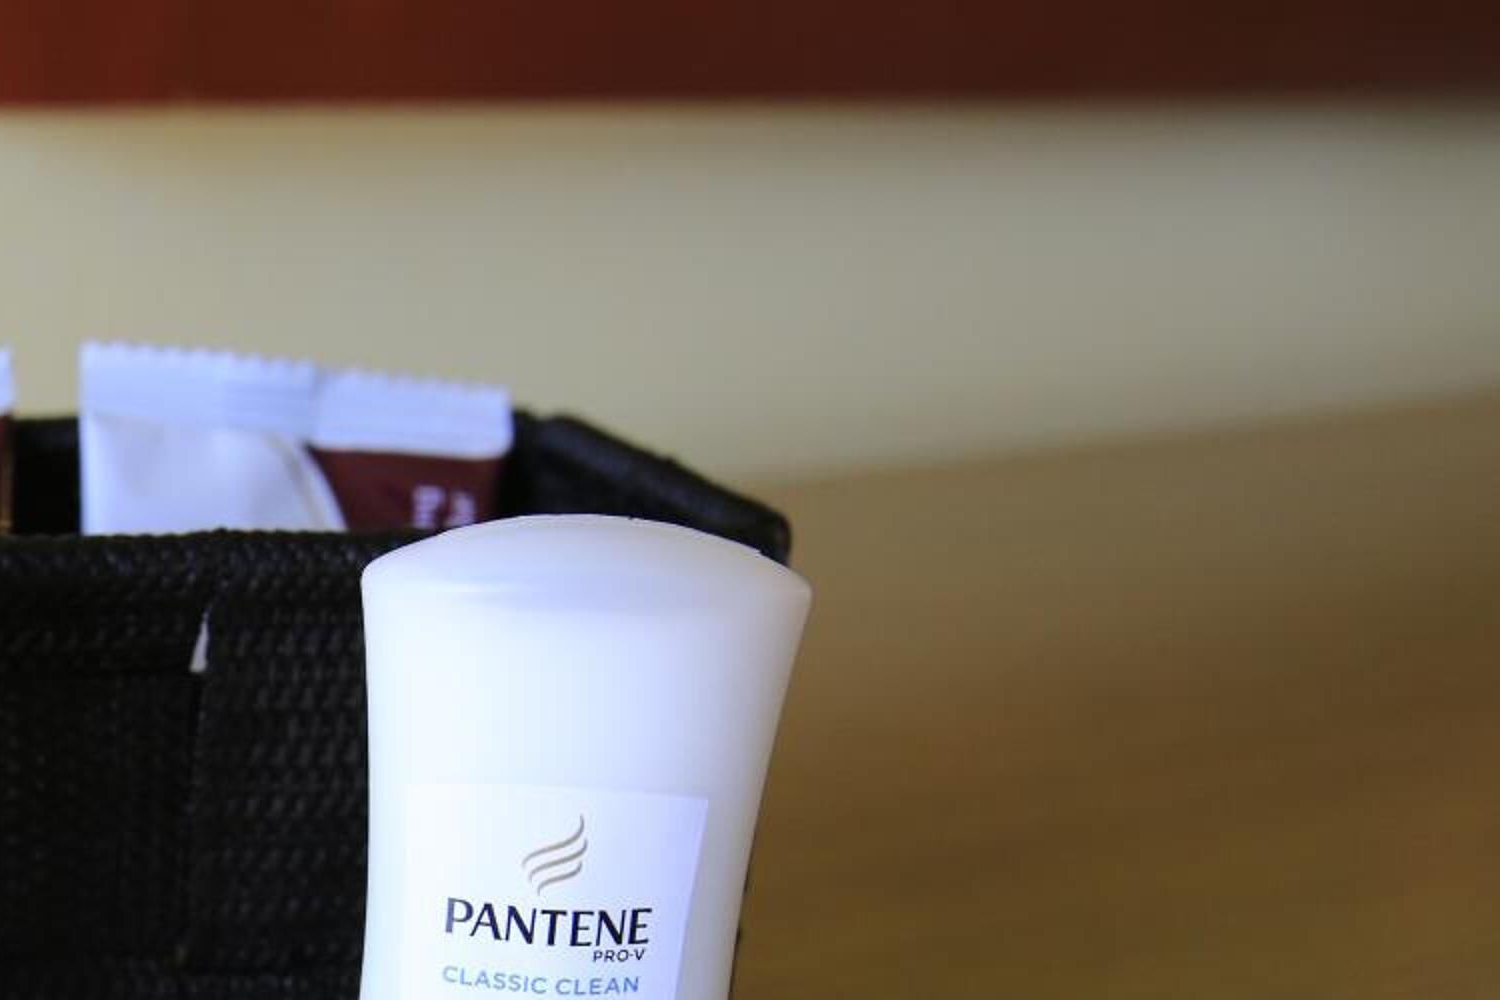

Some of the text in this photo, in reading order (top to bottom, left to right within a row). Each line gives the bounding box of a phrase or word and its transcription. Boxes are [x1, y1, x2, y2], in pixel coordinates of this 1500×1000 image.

[445, 897, 653, 947] PANTENE
[592, 949, 645, 963] PRO-V
[442, 965, 639, 995] CLASSIC CLEAN
